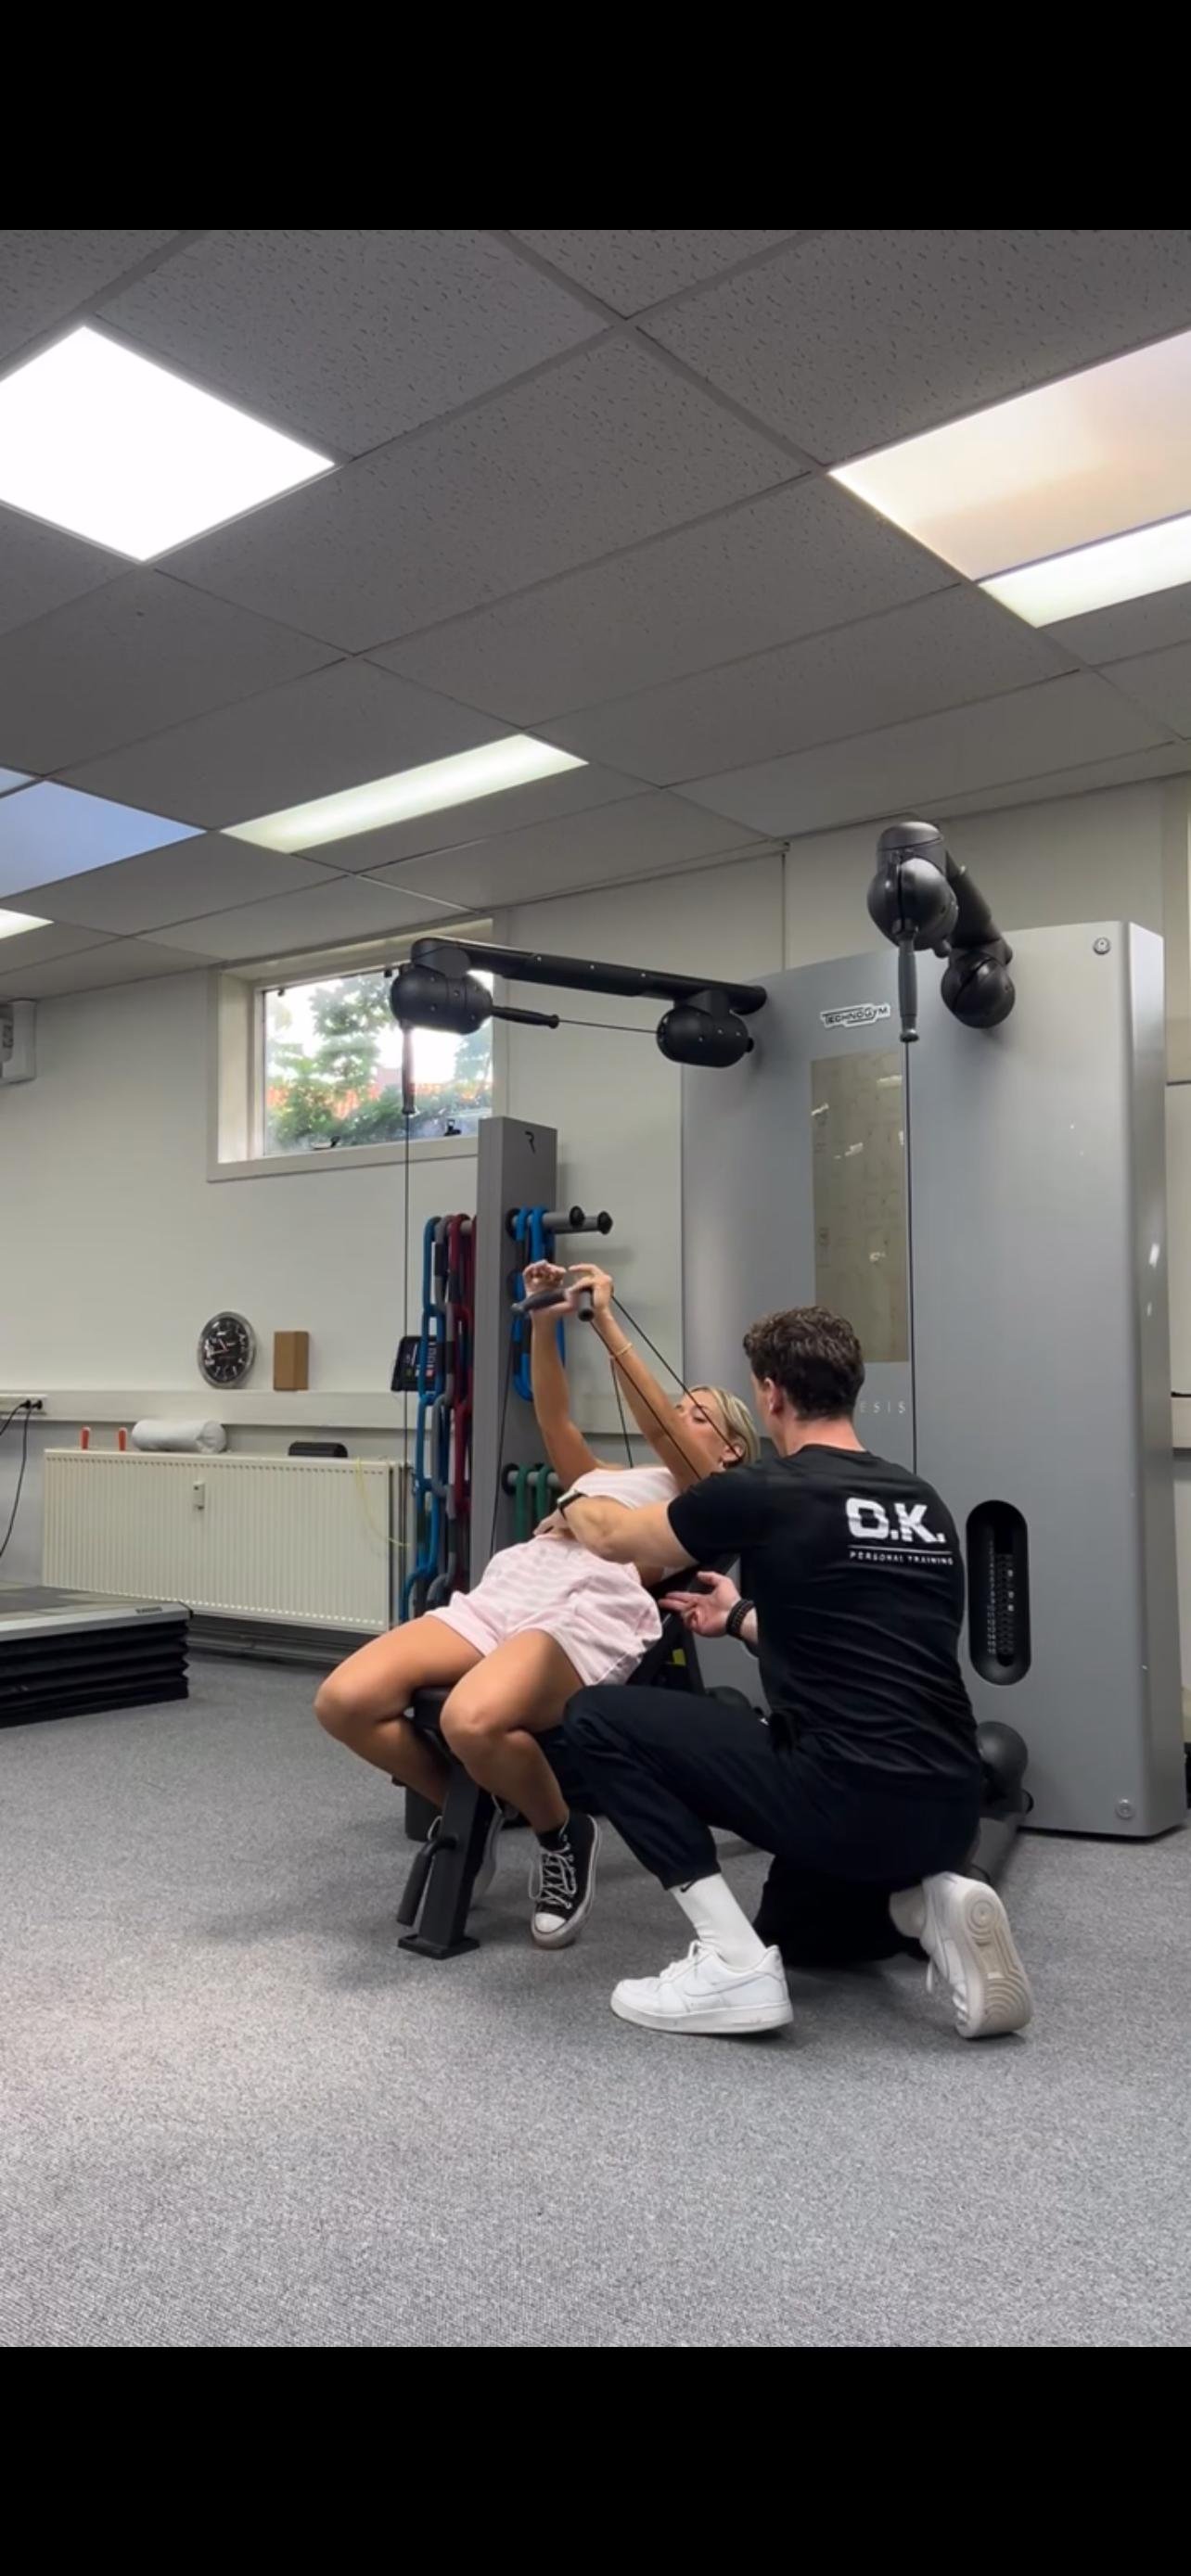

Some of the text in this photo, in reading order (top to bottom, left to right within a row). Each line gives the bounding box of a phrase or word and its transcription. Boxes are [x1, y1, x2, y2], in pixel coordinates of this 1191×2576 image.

[859, 1400, 906, 1414] ESIS
[846, 1497, 946, 1543] O.K.
[850, 1550, 954, 1565] PERSONAL TRAINING
